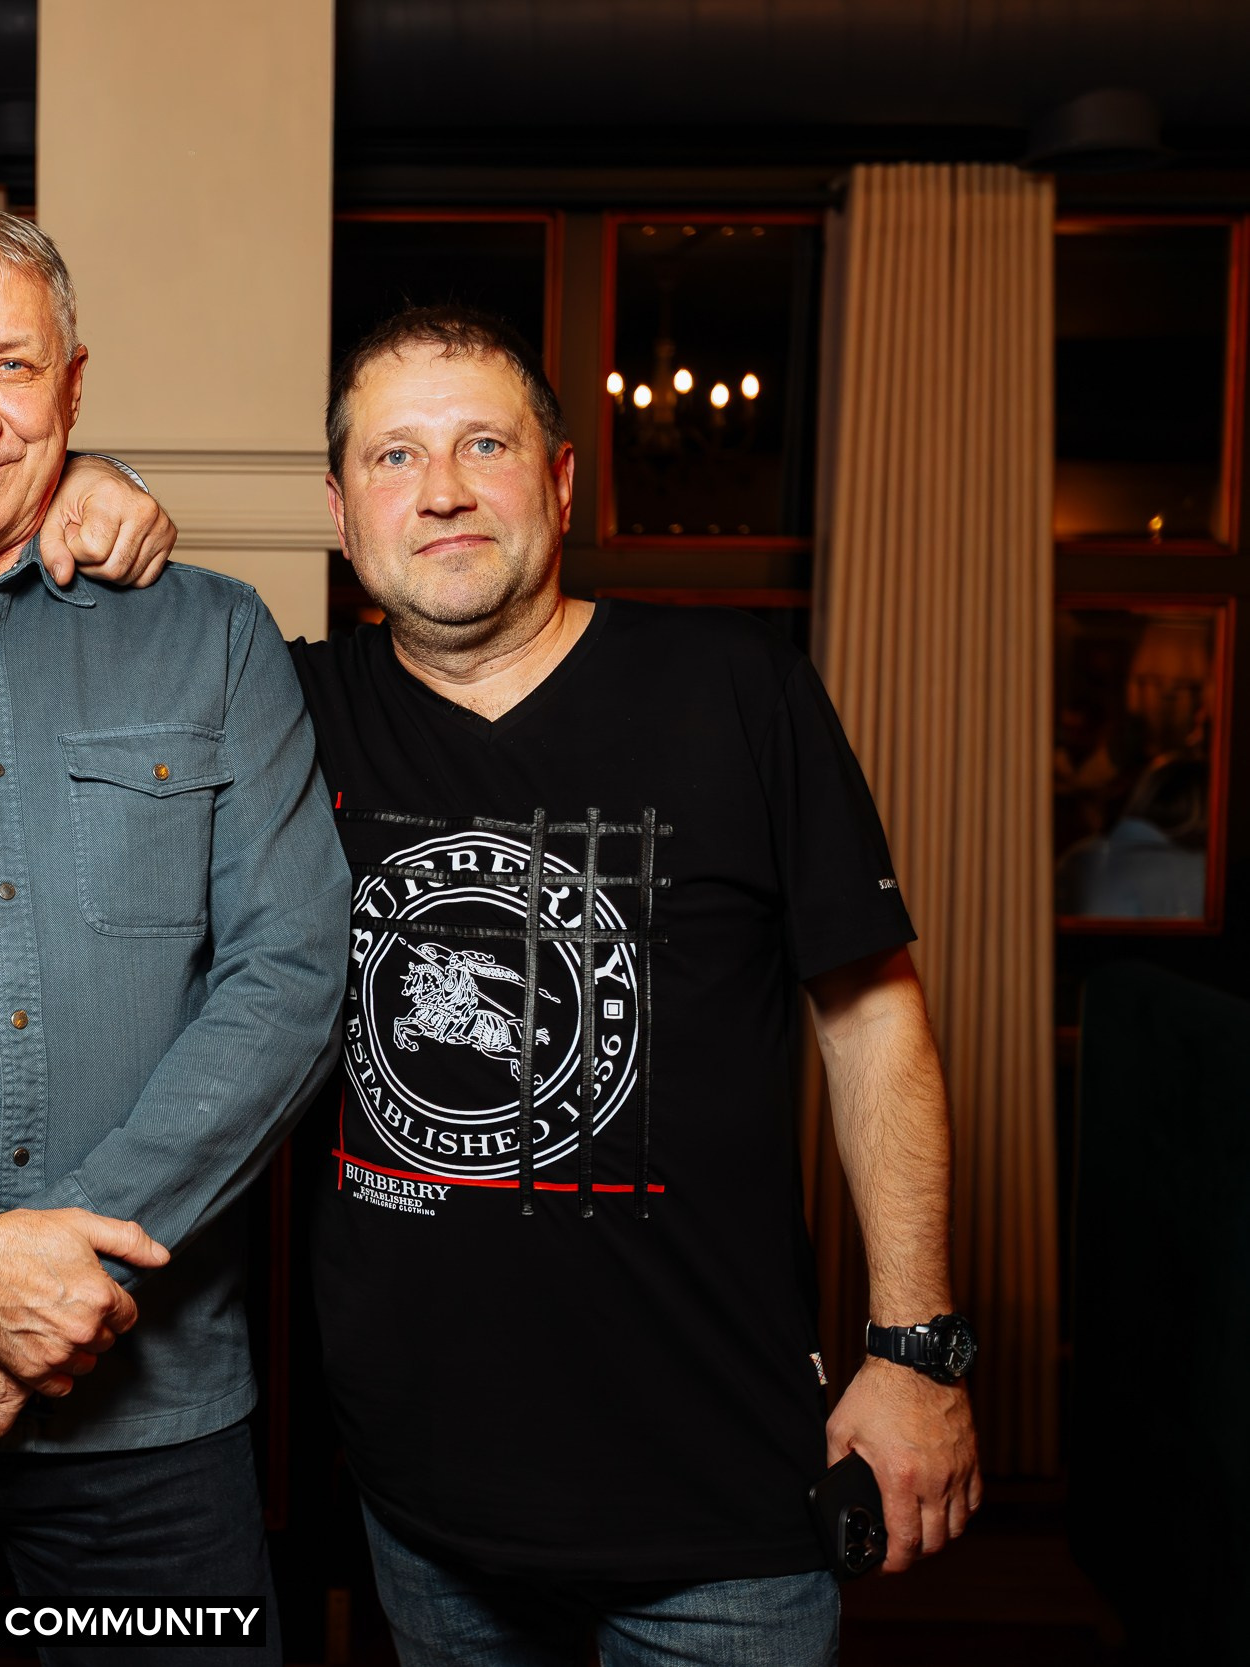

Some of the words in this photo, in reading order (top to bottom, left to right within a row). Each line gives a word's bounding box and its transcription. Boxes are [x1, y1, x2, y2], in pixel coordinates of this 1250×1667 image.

[351, 849, 631, 990] BURBEY
[345, 1163, 451, 1201] BURBERRY
[360, 1185, 423, 1208] ESTABLISHED
[399, 1204, 436, 1216] CLOTHING
